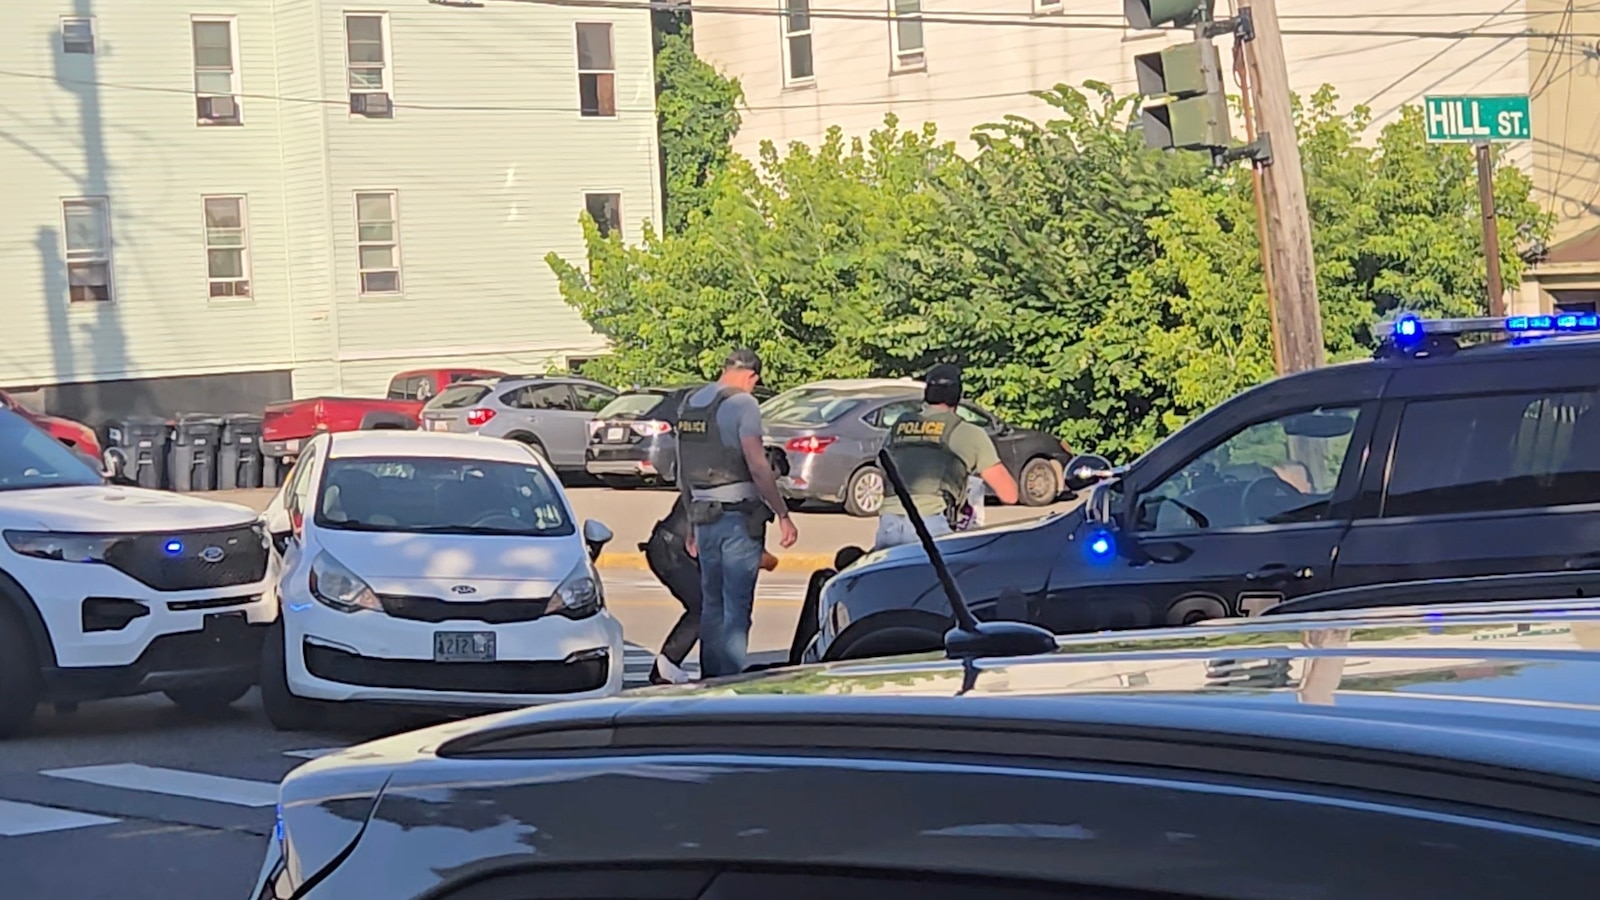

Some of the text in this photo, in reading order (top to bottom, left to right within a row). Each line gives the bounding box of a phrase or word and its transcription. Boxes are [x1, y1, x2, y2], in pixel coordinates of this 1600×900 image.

[1428, 100, 1528, 136] HILL ST.
[678, 420, 706, 433] POLICE
[896, 420, 946, 436] POLICE
